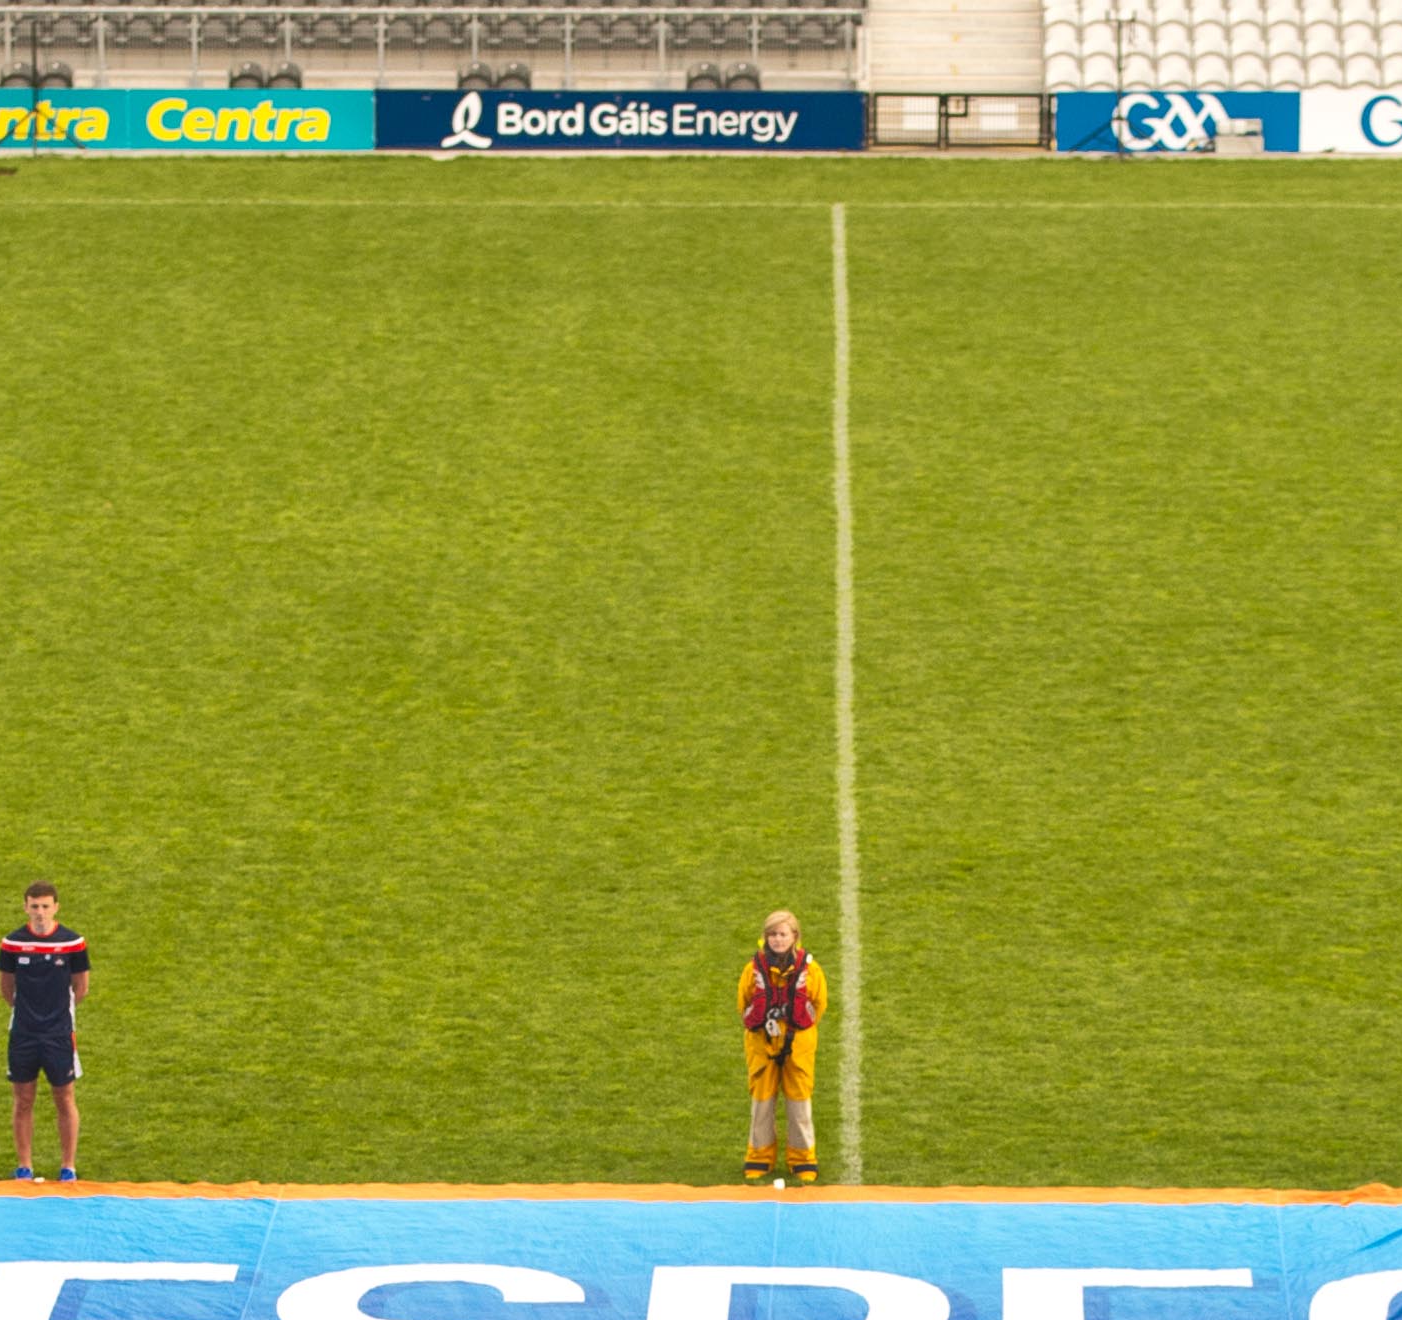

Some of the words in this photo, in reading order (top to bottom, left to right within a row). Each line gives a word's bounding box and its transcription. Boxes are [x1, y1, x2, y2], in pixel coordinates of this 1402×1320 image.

[145, 97, 332, 142] Centra
[496, 101, 586, 136] Bord
[588, 100, 668, 136] Gáis
[672, 104, 798, 143] Energy
[1111, 93, 1230, 151] GAA
